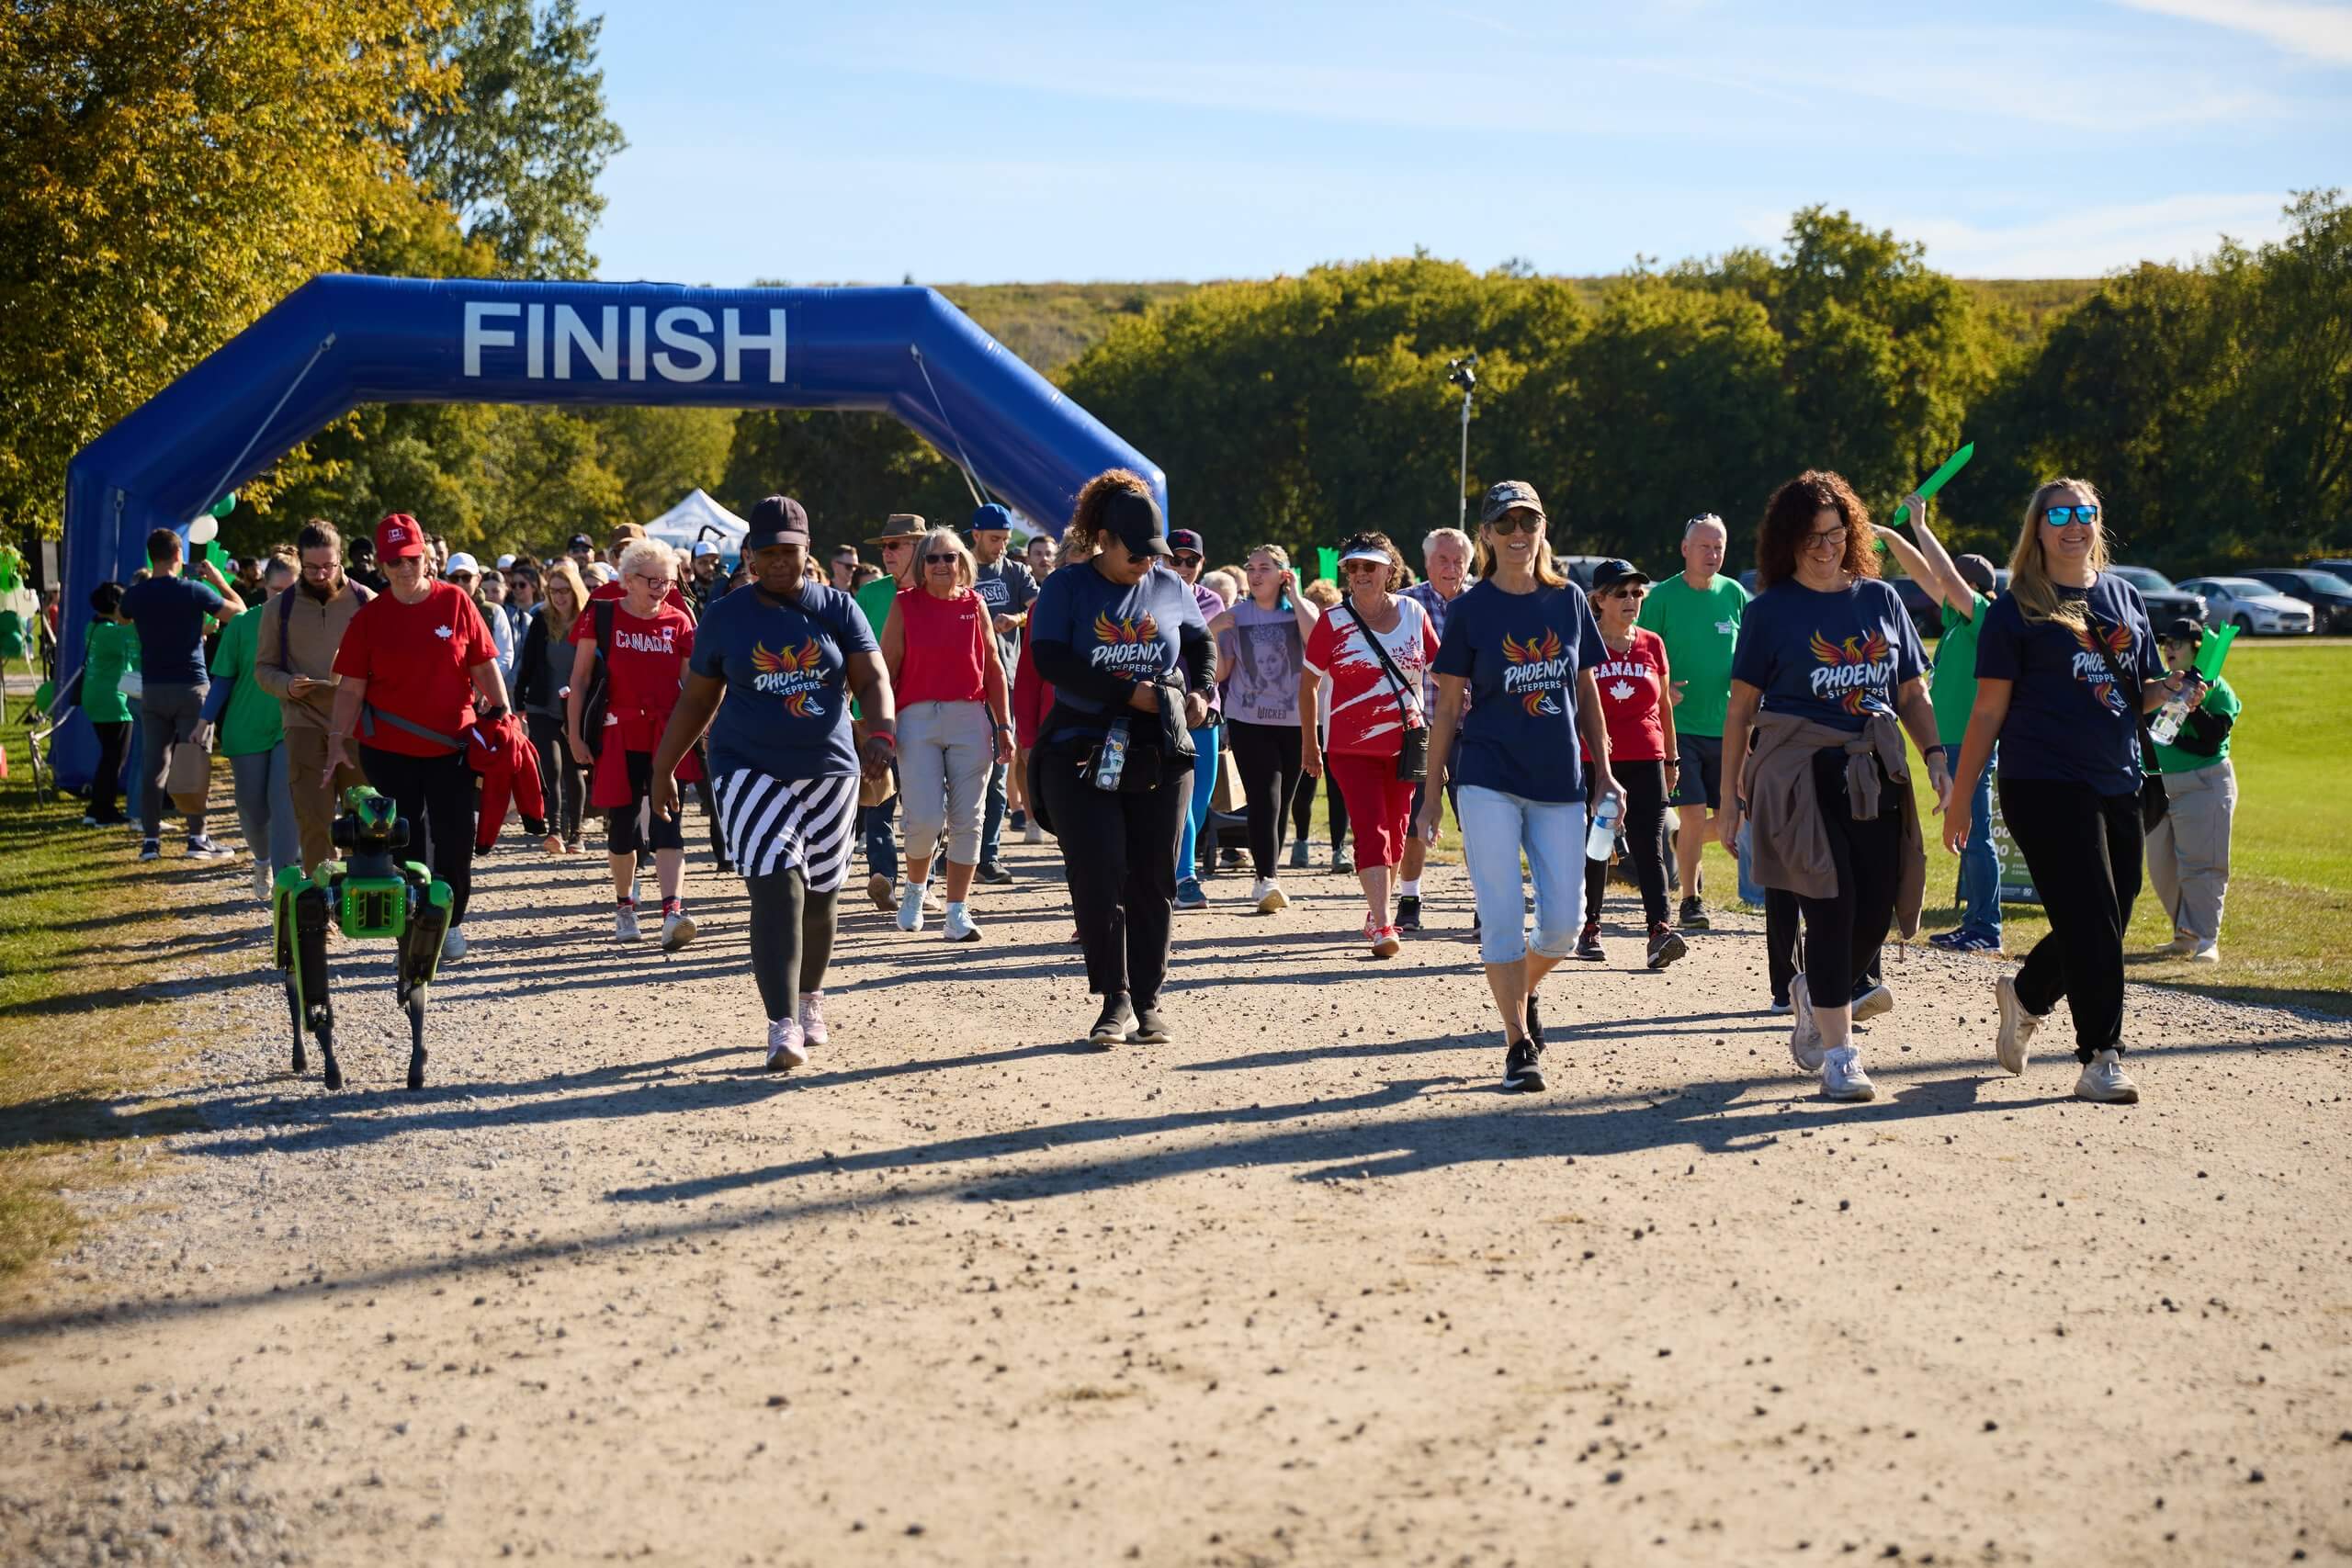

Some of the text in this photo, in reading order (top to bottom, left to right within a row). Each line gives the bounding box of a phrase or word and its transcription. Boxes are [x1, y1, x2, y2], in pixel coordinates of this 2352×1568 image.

[464, 301, 786, 383] FINISH
[616, 629, 673, 654] CANADA
[1091, 641, 1166, 668] PHOENIX
[1504, 657, 1569, 693] PHOENIX
[1516, 680, 1563, 694] STEPPERS
[1810, 661, 1894, 696] PHOENIX
